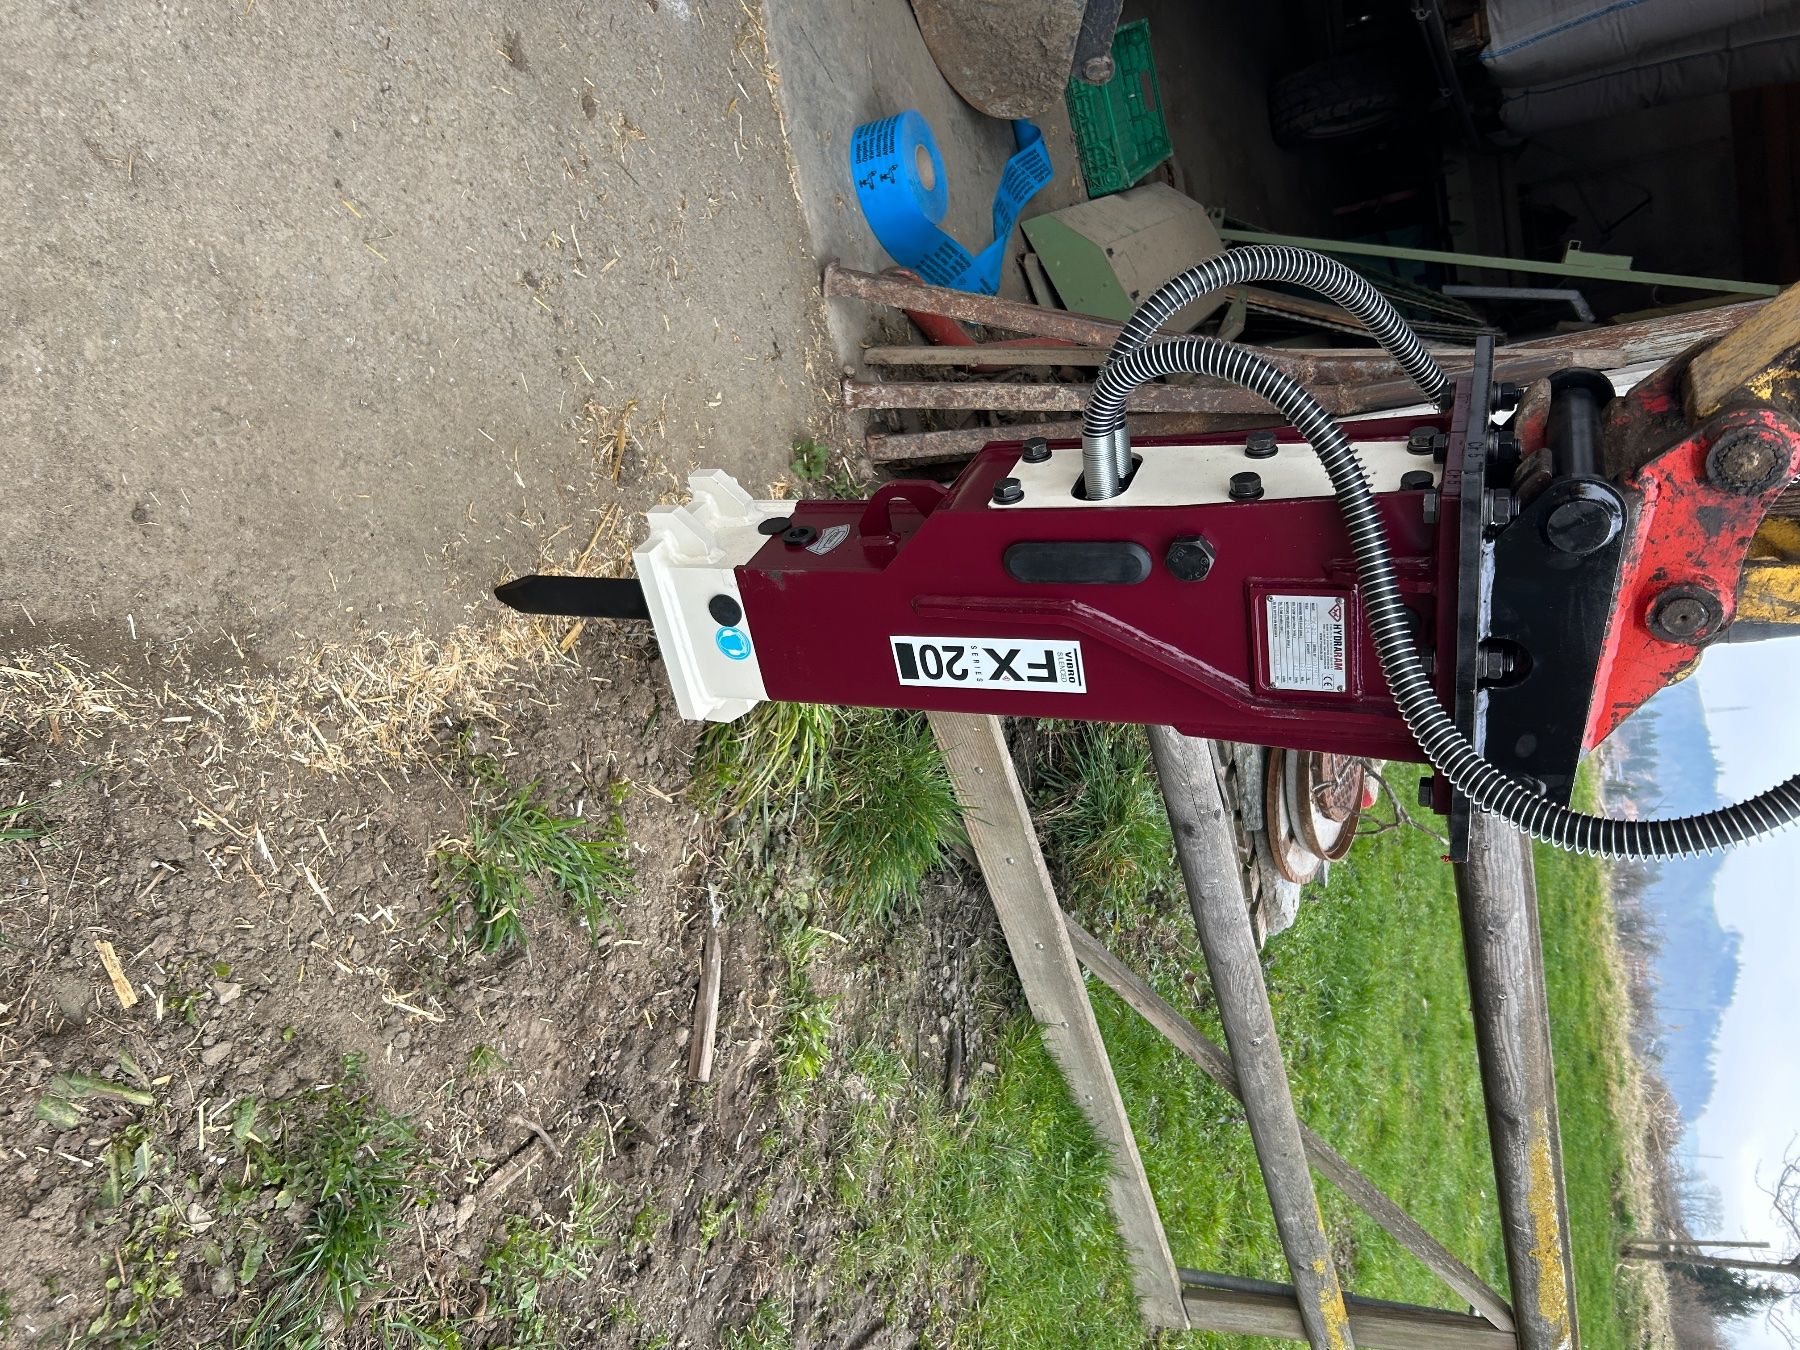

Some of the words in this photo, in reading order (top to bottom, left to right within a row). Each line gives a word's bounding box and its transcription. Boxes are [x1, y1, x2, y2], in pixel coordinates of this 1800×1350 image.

[919, 644, 969, 681] 20
[970, 645, 984, 682] SERIES
[982, 647, 1059, 683] FX
[1333, 624, 1343, 671] HYDRARAM
[1057, 651, 1067, 683] SILENCED
[1064, 651, 1076, 684] VIBRO
